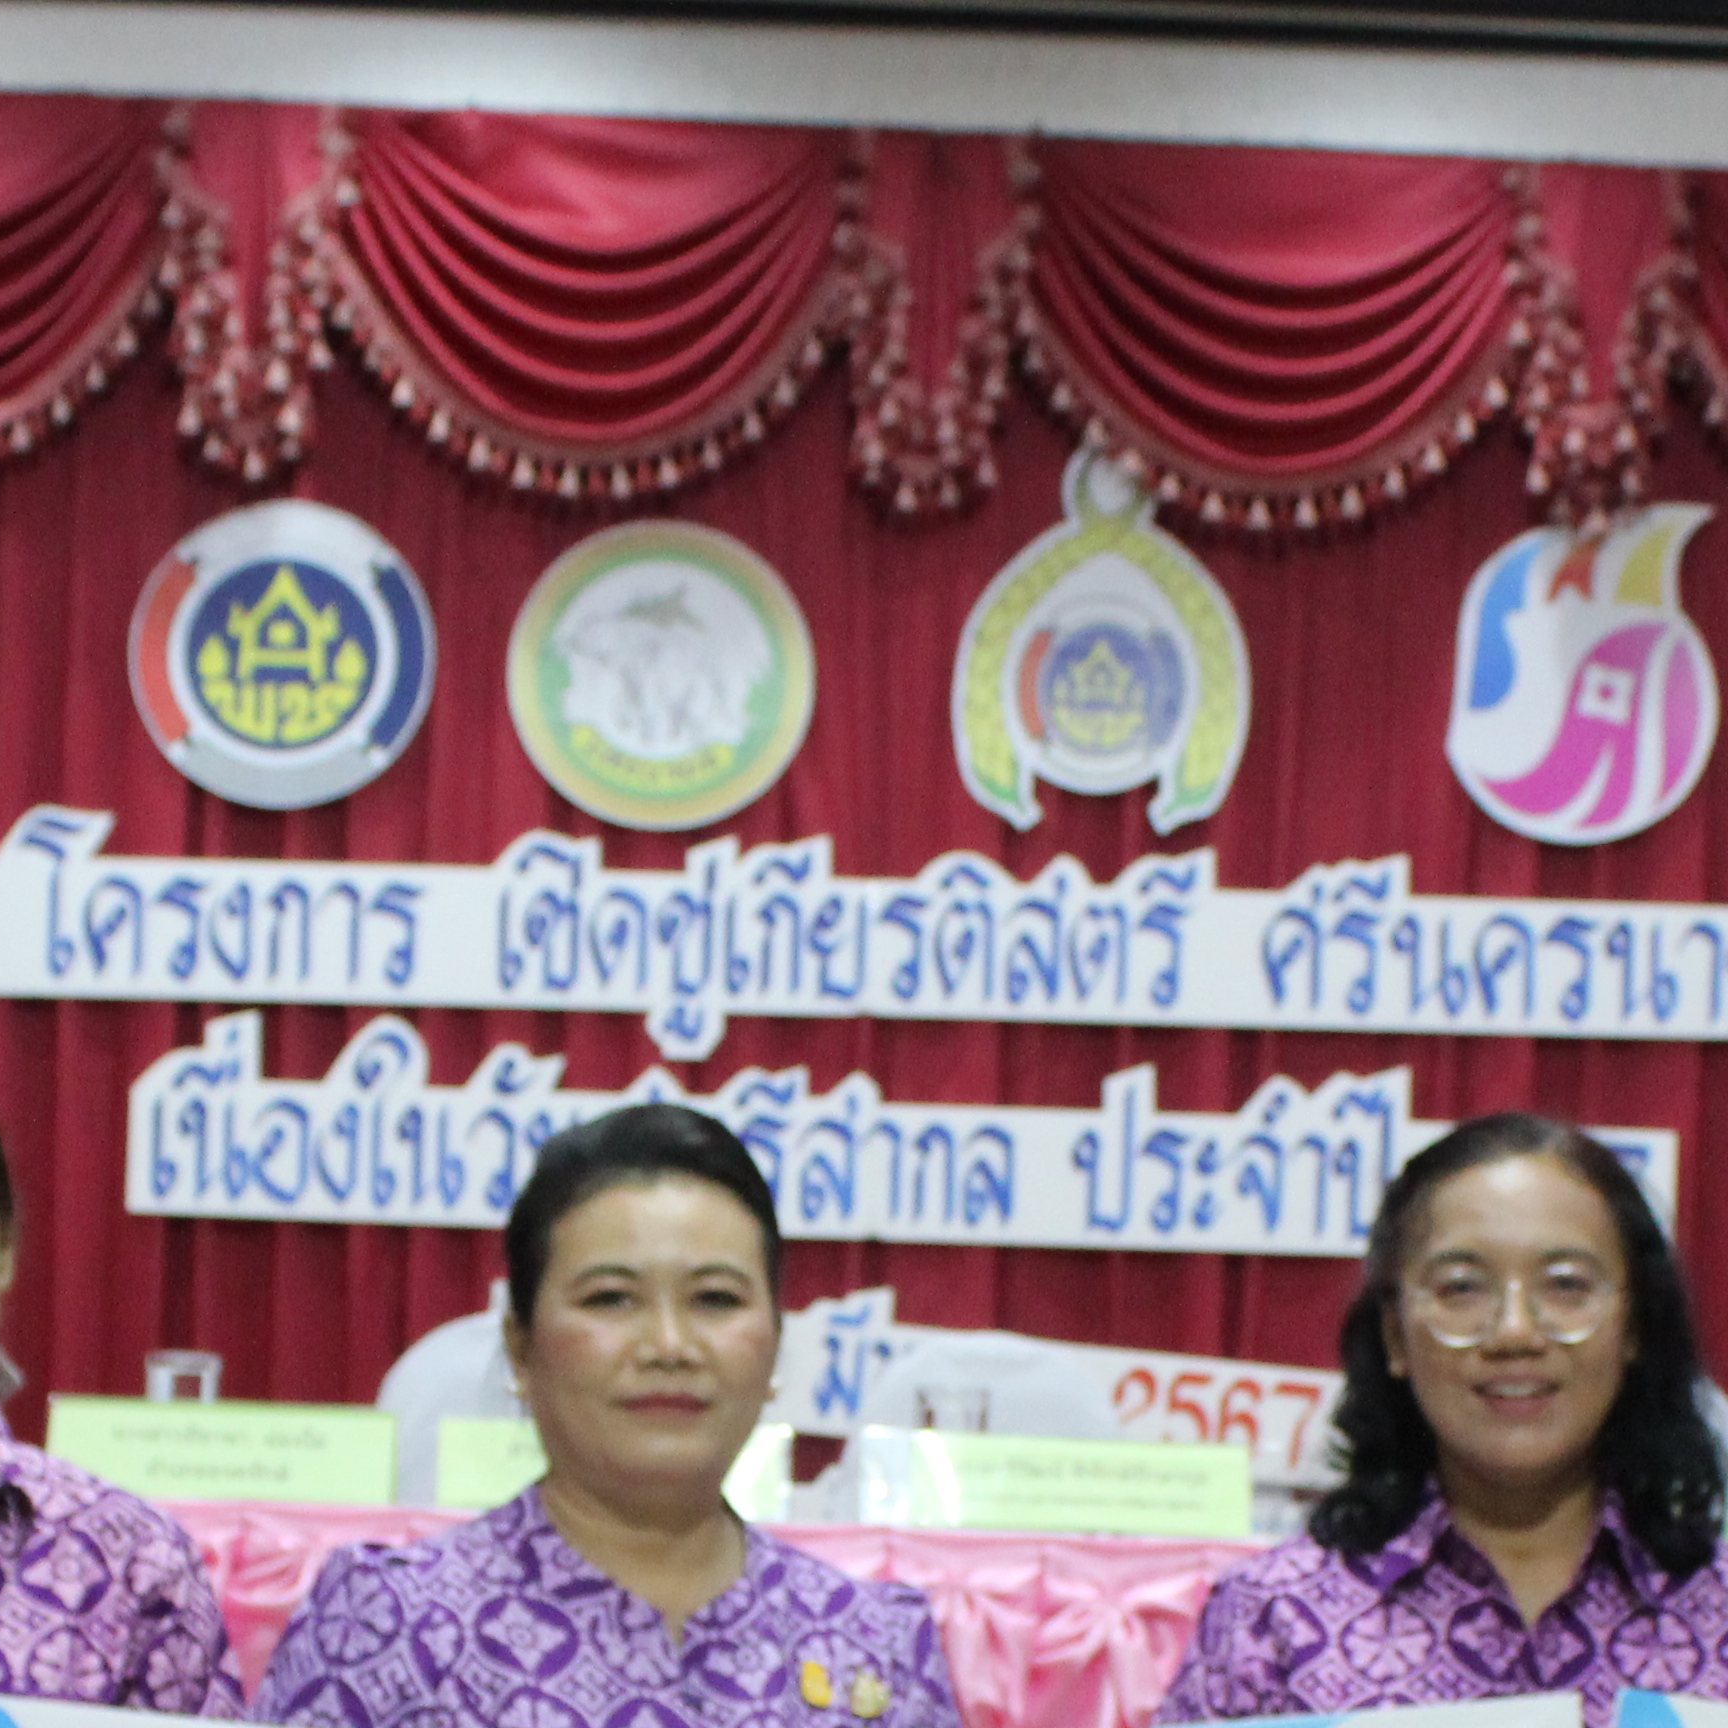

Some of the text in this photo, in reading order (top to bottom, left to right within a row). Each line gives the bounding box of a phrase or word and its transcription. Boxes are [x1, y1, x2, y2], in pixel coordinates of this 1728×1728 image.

[20, 815, 424, 989] โครงการ
[1112, 1368, 1322, 1470] 2567
